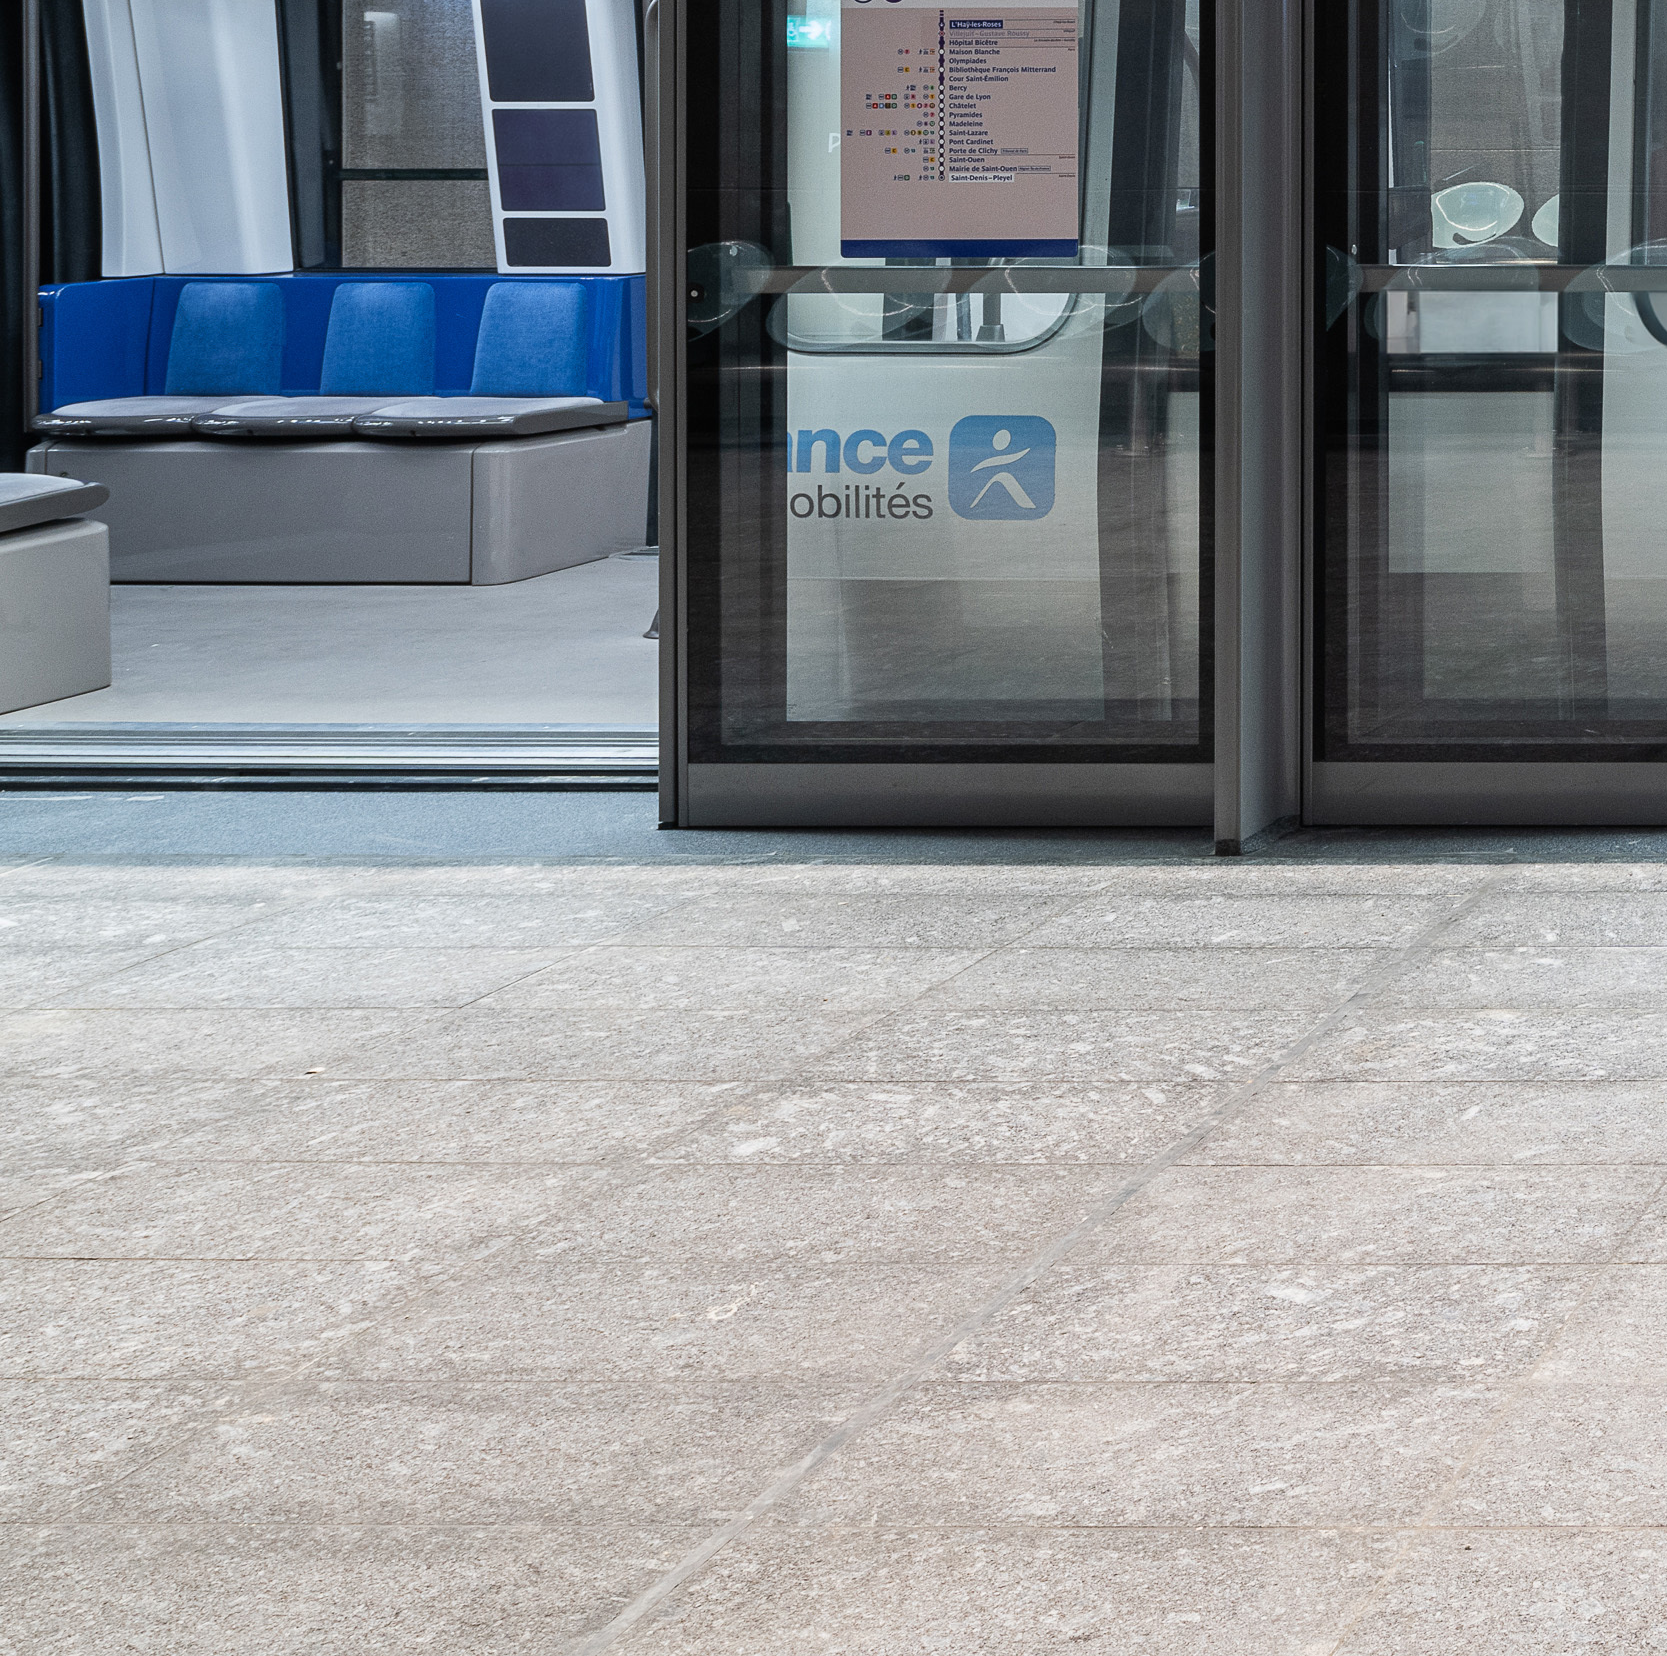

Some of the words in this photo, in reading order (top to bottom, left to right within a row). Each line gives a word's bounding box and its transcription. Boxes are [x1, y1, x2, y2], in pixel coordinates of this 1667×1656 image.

[951, 21, 1002, 29] L'Haÿ-les-Roses
[949, 39, 974, 47] Hôpital
[949, 57, 987, 65] Olympiades
[949, 84, 968, 92] Bercy
[976, 93, 991, 101] Lyon
[949, 111, 983, 119] Pyramides
[978, 147, 998, 155] Clichy
[993, 174, 1013, 182] Pleyel
[787, 429, 934, 475] nce
[790, 482, 934, 520] obilités
